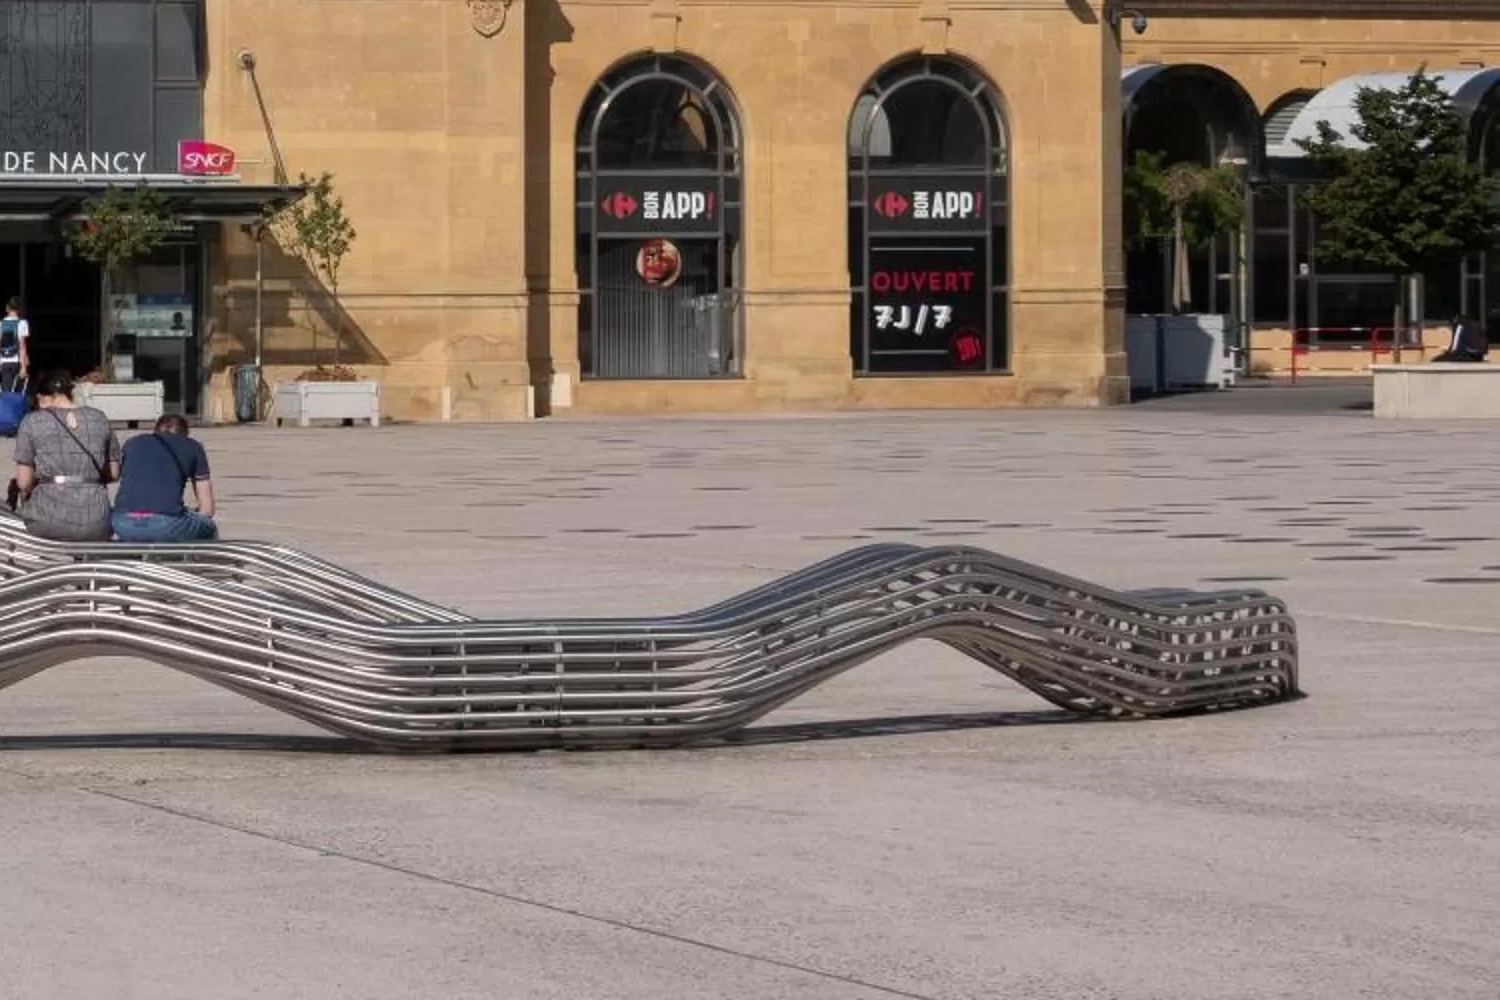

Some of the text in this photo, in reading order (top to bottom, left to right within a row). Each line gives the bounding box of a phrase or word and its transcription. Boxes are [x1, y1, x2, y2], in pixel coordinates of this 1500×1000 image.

[4, 151, 36, 172] DE
[49, 151, 147, 173] NANCY
[184, 152, 231, 168] SNCF
[643, 191, 659, 218] BON
[913, 191, 929, 219] BON
[872, 271, 973, 291] OUVERT
